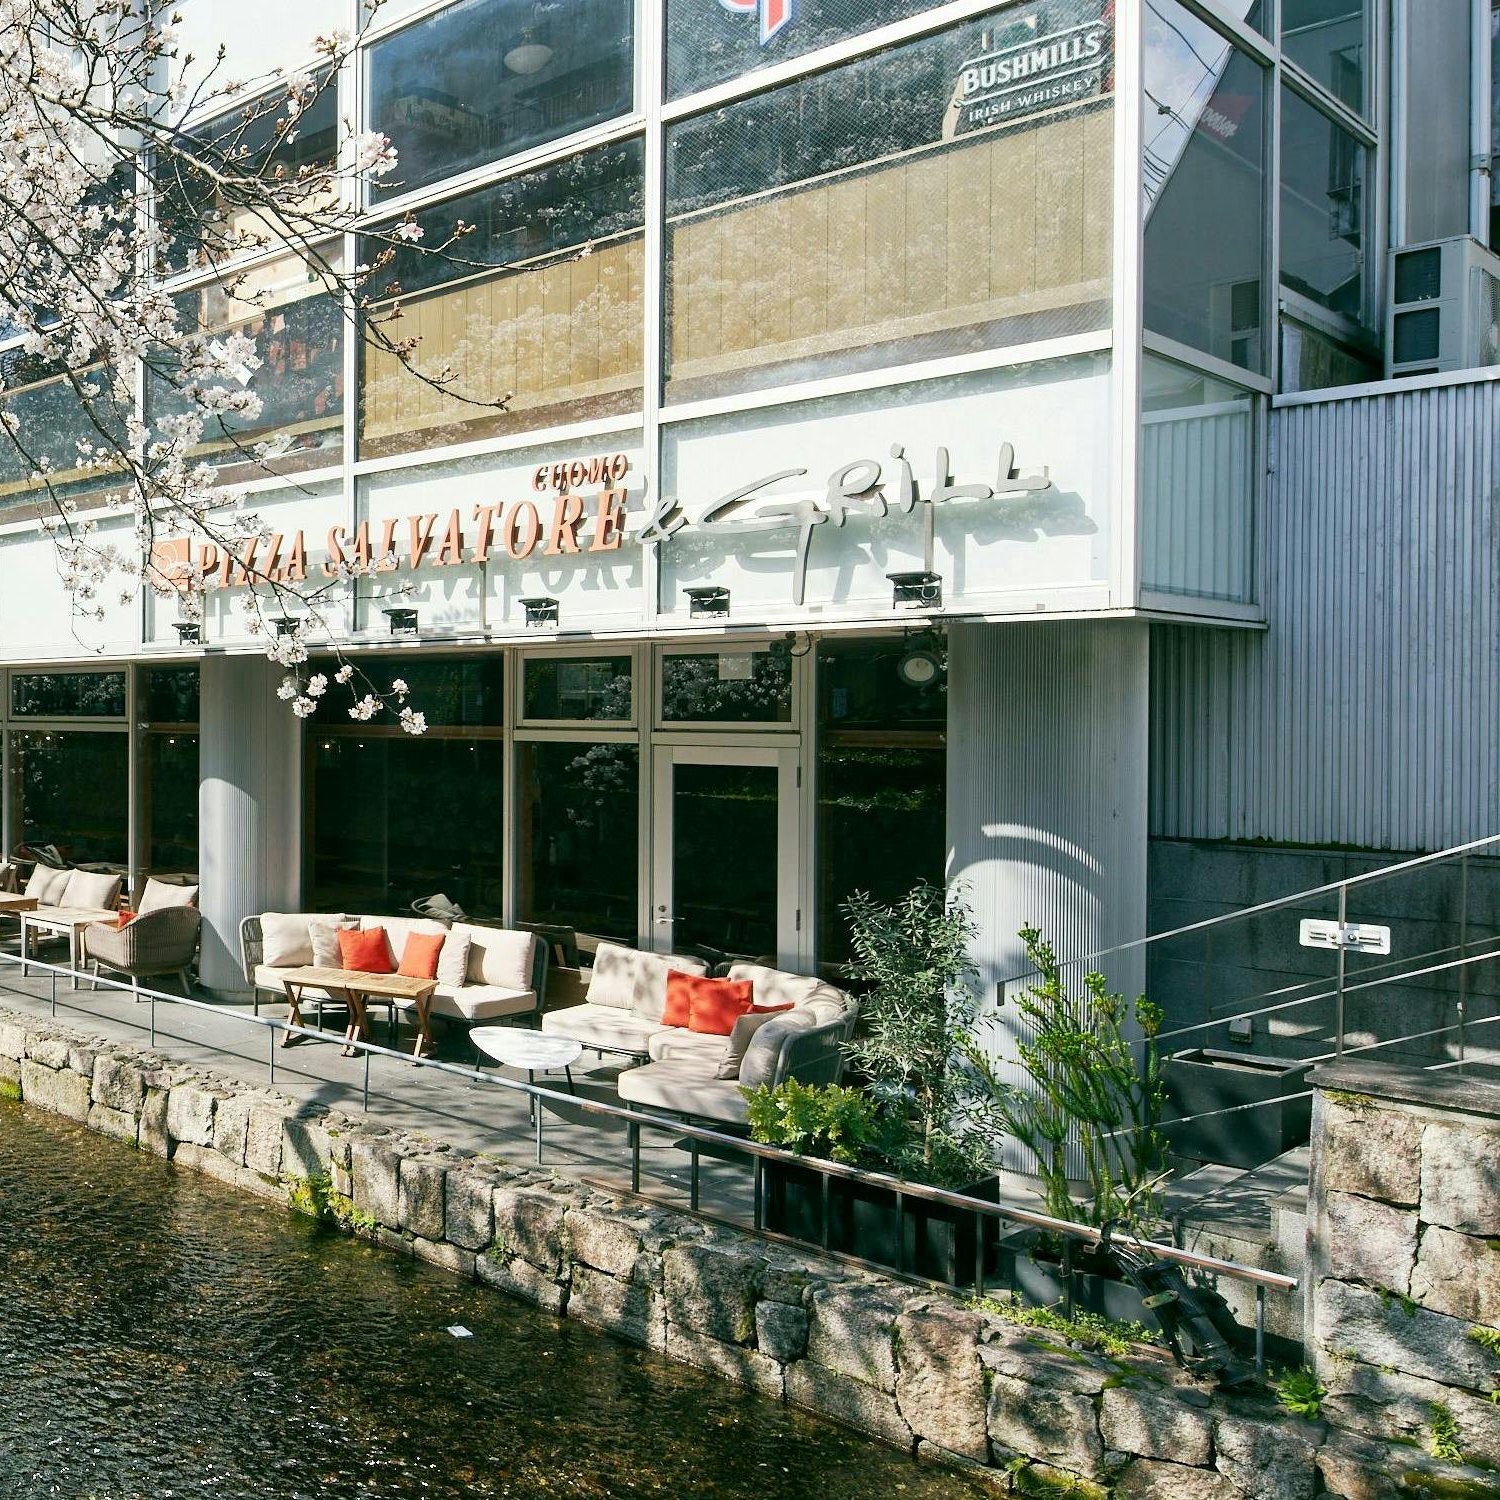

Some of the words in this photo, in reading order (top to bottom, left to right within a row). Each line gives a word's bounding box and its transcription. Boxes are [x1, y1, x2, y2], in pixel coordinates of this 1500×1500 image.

[963, 31, 1101, 95] BUSHMILLS
[969, 101, 1011, 122] IRISH
[1018, 77, 1094, 107] WHISKEY
[532, 454, 629, 491] CUOMO
[198, 530, 308, 590] PIZZA
[323, 488, 628, 577] SALVATORE
[635, 495, 688, 544] &
